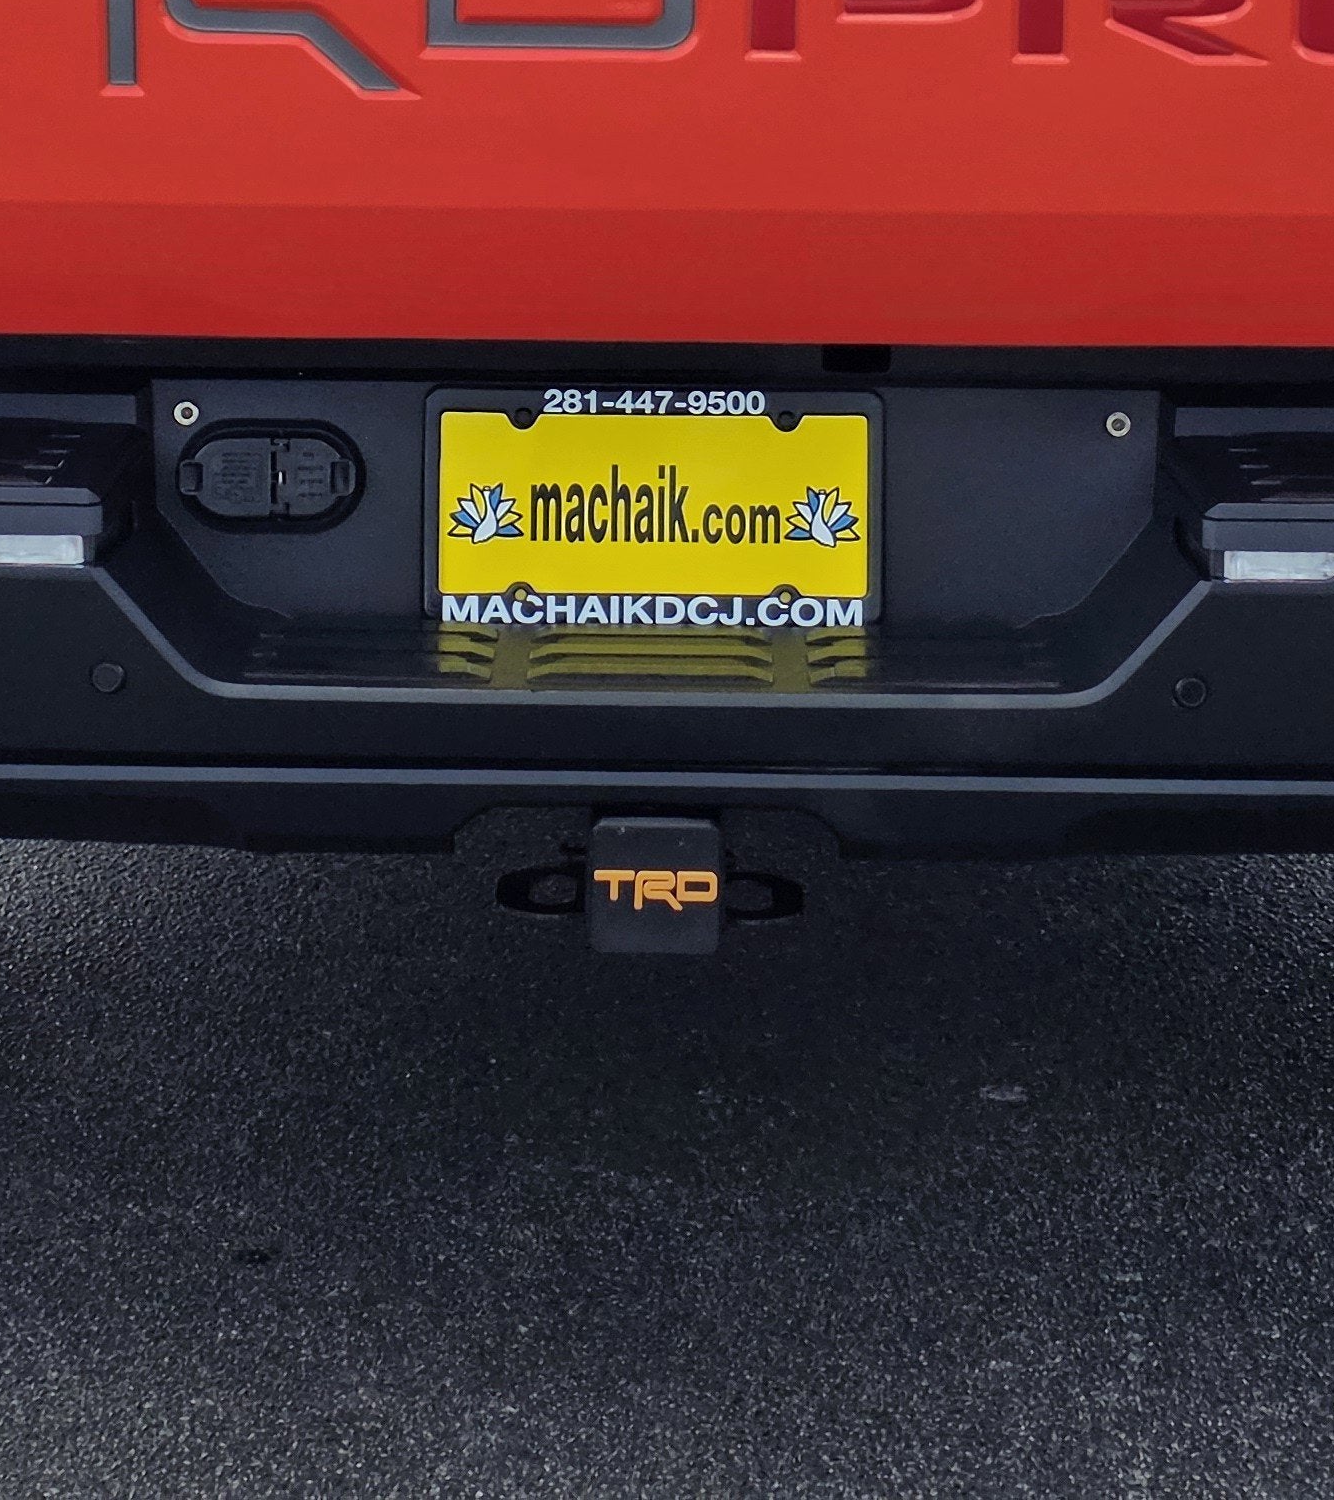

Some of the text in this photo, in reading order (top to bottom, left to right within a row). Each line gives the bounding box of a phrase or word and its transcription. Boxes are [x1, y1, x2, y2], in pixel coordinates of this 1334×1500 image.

[543, 389, 766, 414] 281-447-9500
[530, 464, 780, 544] machaik.com
[441, 594, 863, 627] MACHAIKDCJ.COM
[593, 869, 718, 911] TRD
